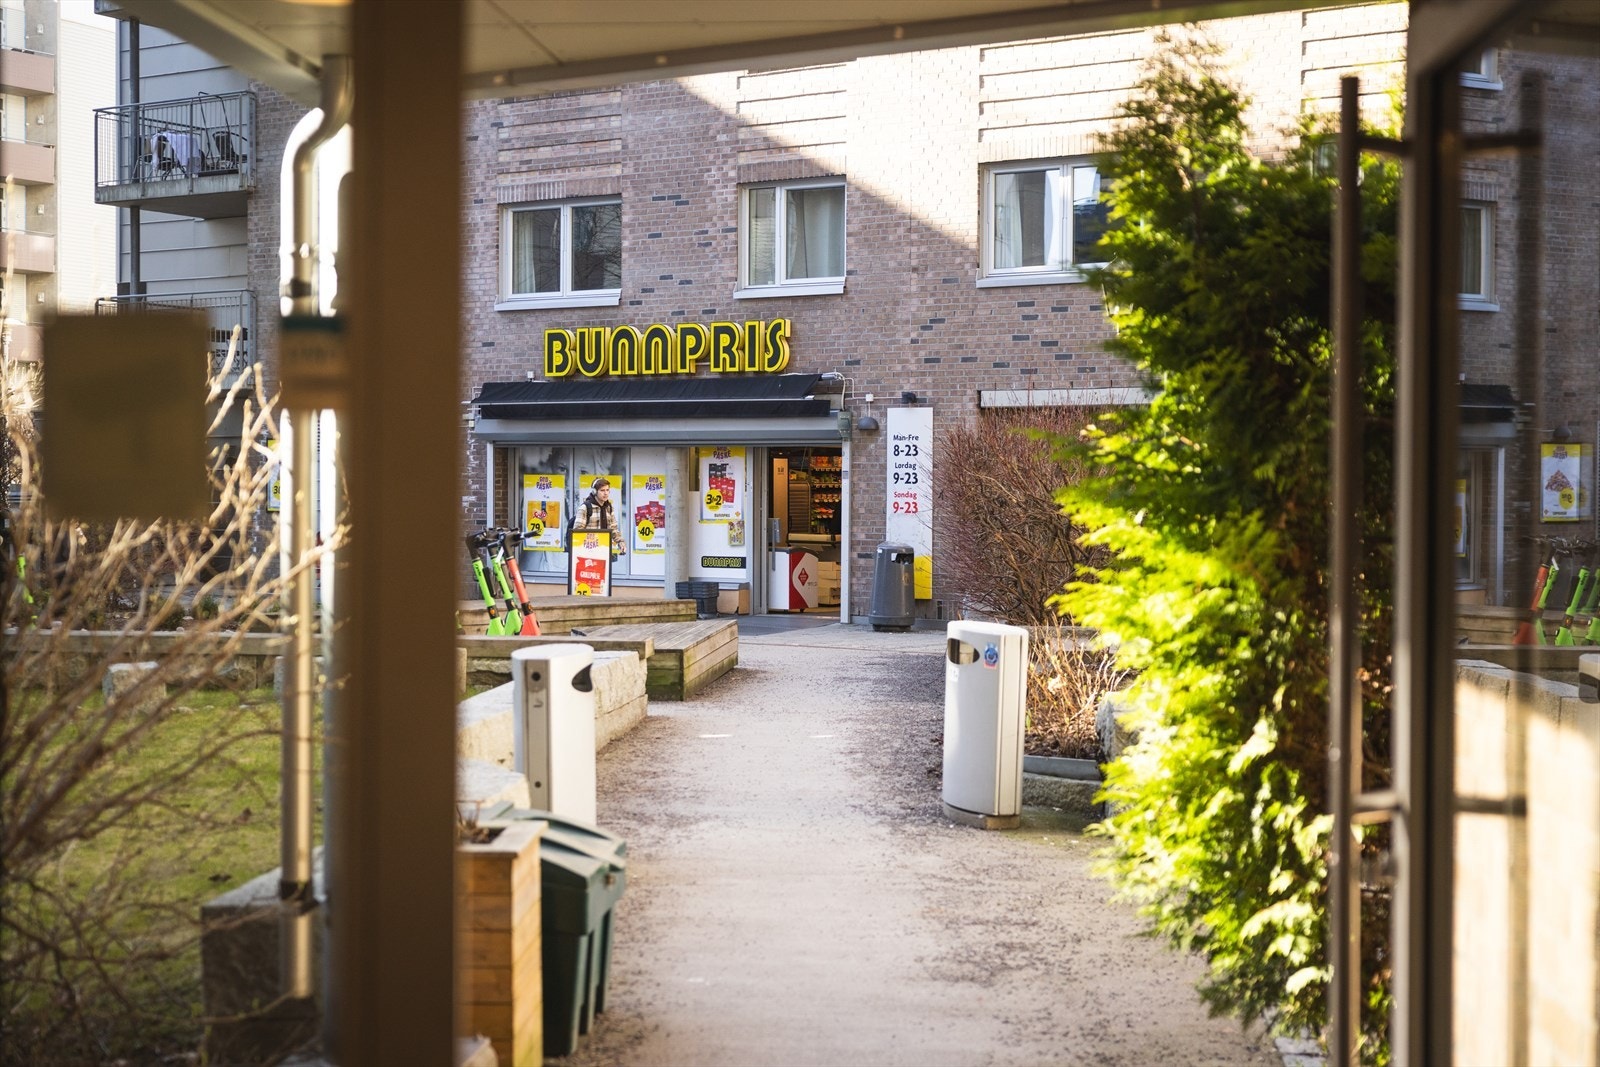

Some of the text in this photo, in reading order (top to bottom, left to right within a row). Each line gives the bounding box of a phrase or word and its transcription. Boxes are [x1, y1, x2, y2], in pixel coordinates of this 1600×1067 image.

[543, 318, 791, 378] BUNNPRIS
[893, 444, 918, 457] 8-23
[893, 472, 918, 484] 9-23
[893, 501, 918, 514] 9-23
